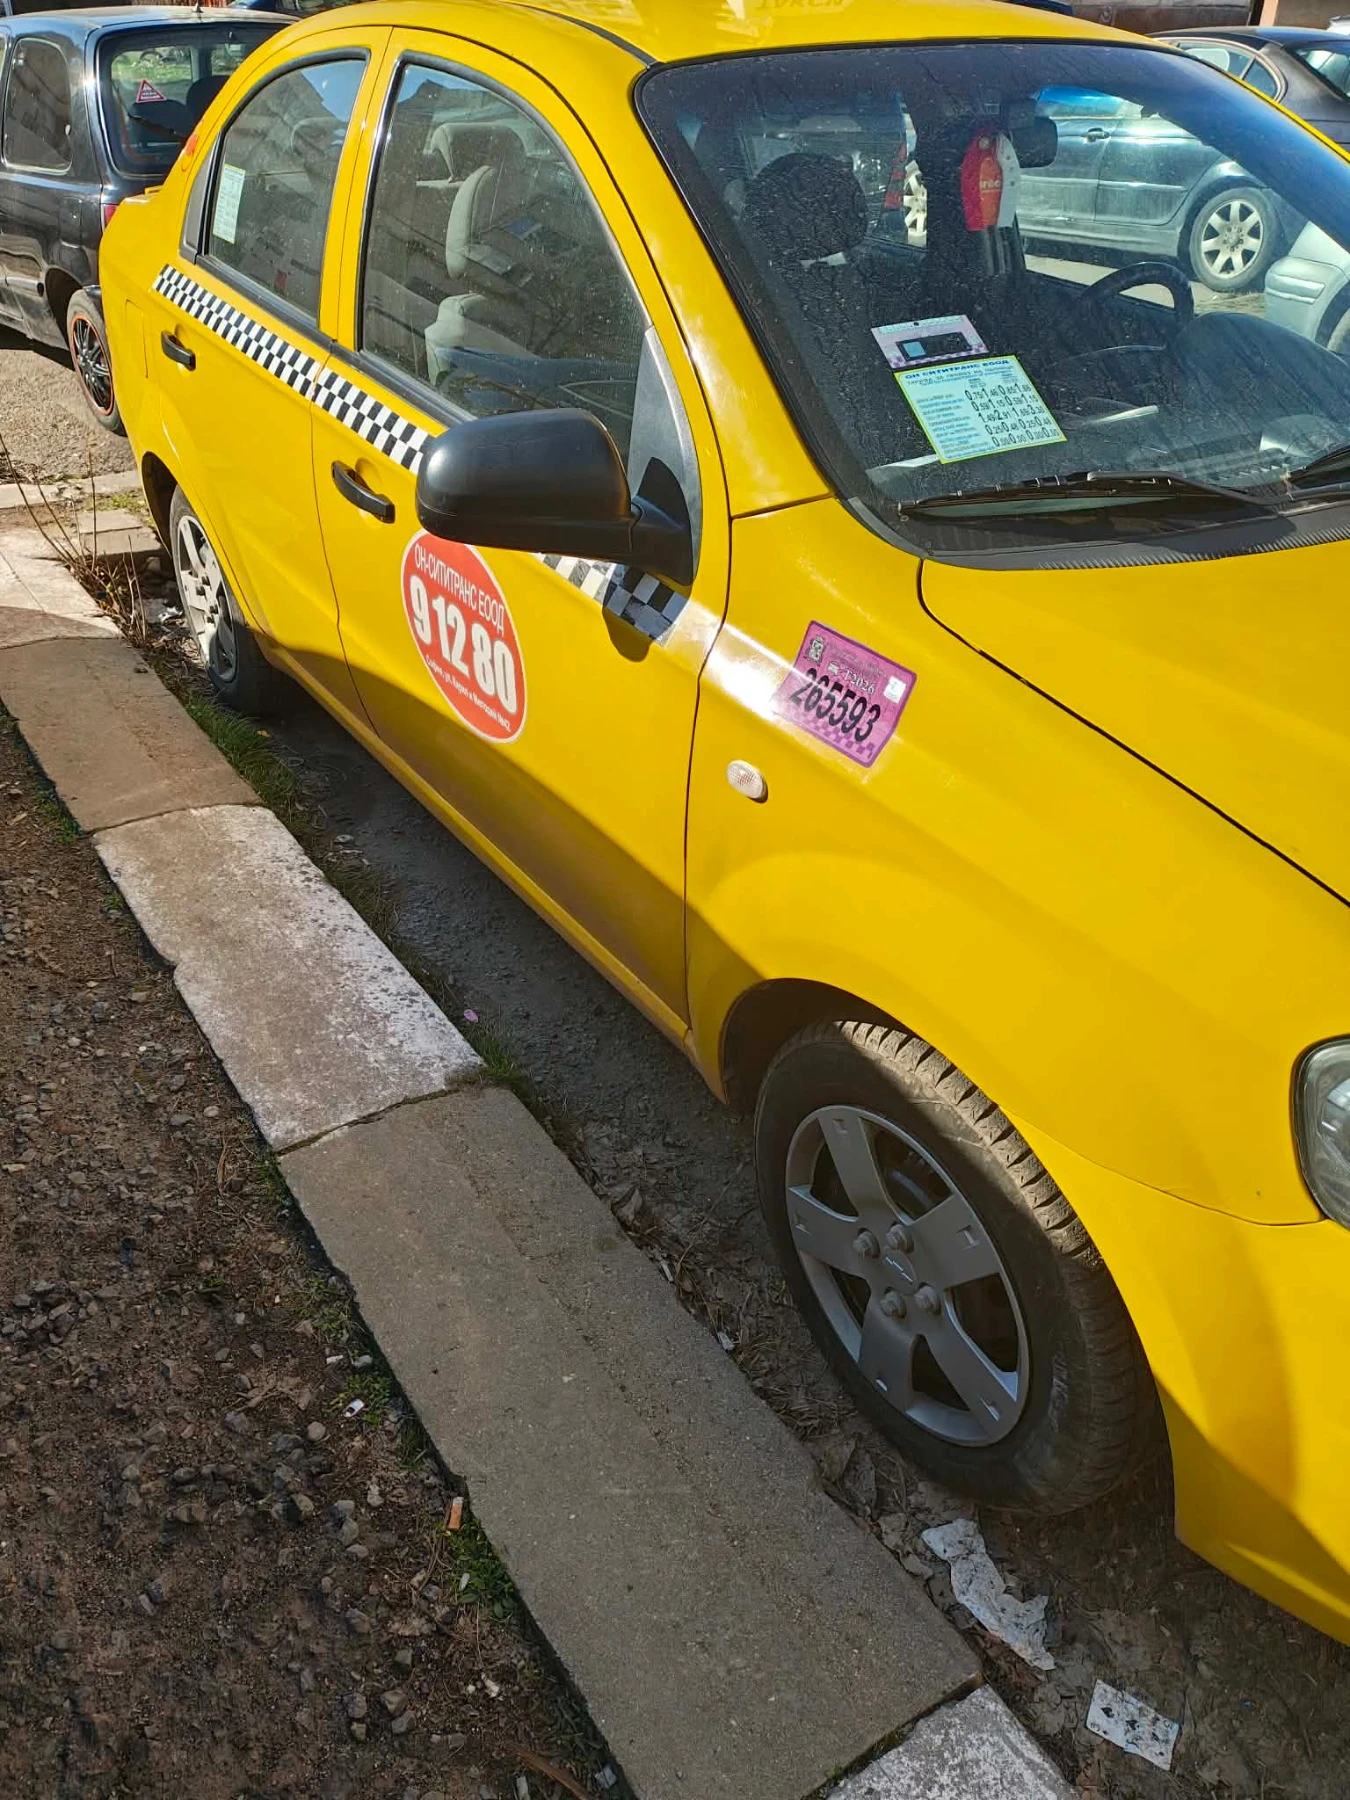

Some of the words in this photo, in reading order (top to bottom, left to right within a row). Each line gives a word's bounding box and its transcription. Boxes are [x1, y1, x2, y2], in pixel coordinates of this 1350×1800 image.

[414, 543, 477, 611] ОН-СИТИТРАНС
[478, 593, 505, 636] ЕООД
[789, 668, 881, 742] 265593
